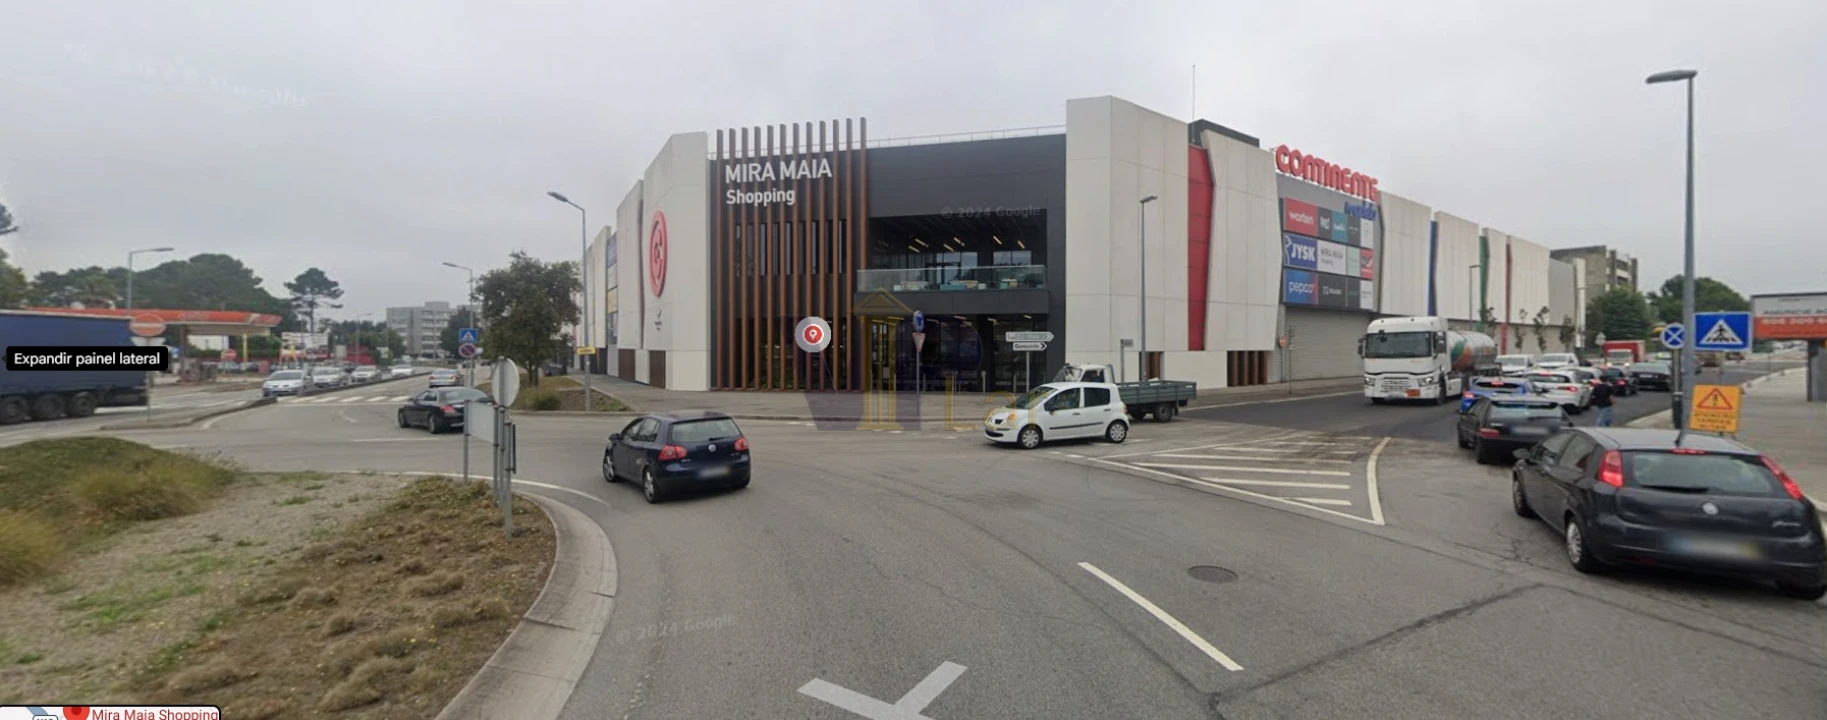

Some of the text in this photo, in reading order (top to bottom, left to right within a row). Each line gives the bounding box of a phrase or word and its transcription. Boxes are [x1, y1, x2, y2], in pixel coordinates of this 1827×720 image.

[725, 158, 832, 183] MIRA MAIA
[726, 187, 796, 207] Shopping
[1289, 211, 1314, 225] worten
[1291, 241, 1316, 262] JYSK
[1289, 280, 1314, 296] pepco
